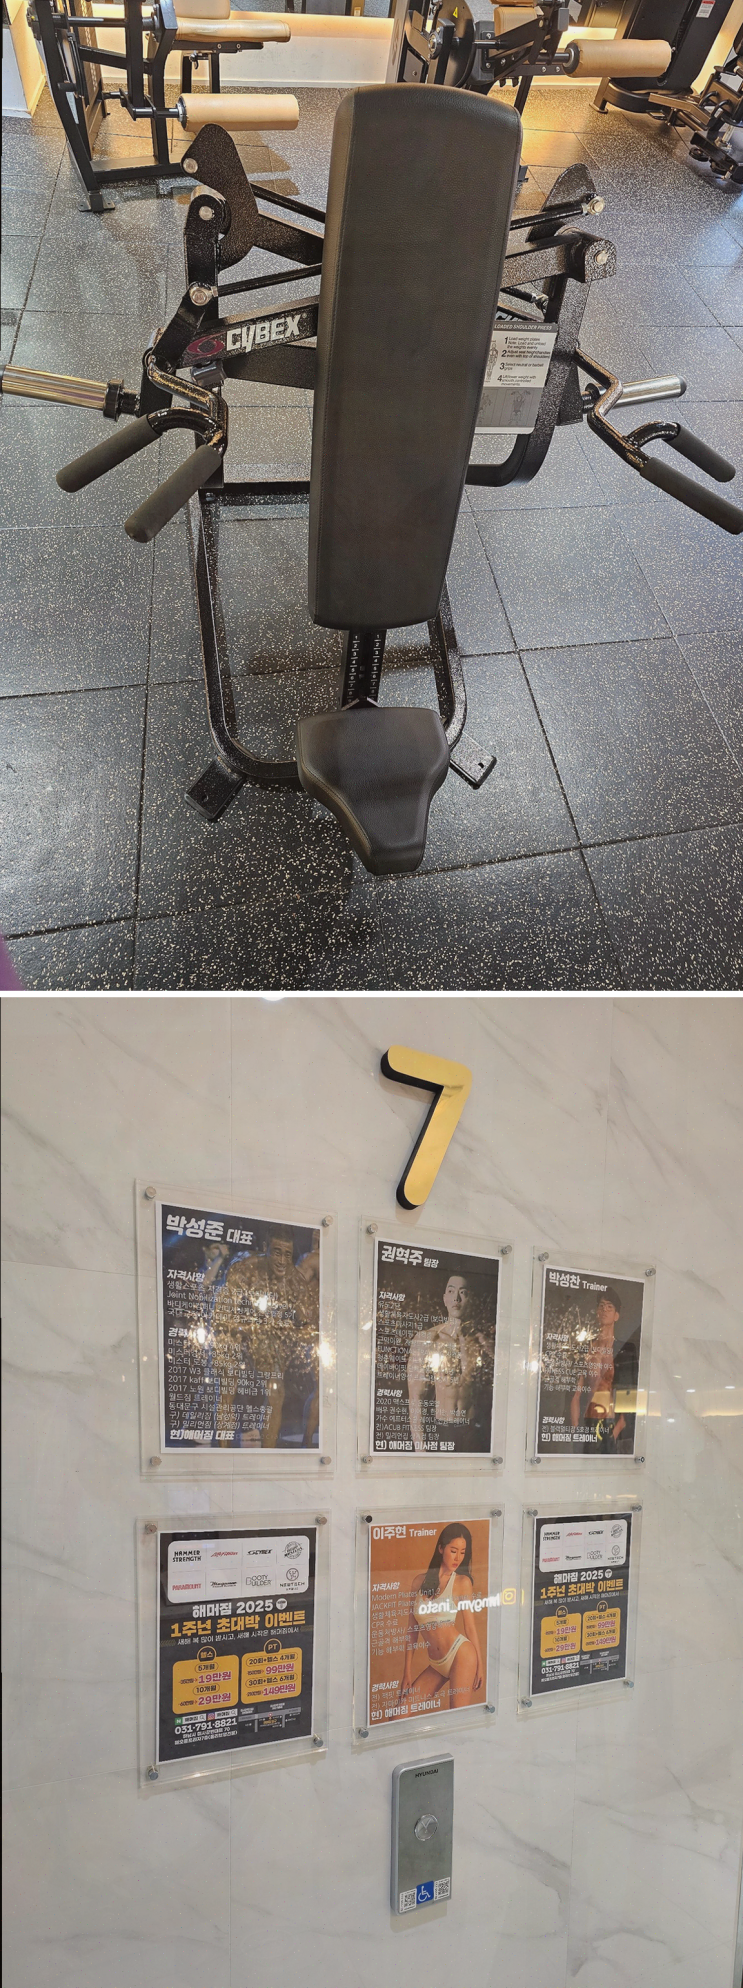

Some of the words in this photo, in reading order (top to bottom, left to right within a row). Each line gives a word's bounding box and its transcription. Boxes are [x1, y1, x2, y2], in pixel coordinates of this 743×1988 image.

[226, 313, 302, 352] CYBEX
[380, 1044, 472, 1210] 7
[166, 1214, 224, 1241] 박성준
[226, 1228, 254, 1244] 대표
[381, 1245, 424, 1266] 권혁주
[423, 1258, 439, 1268] 팀장
[167, 1269, 205, 1282] 자격사항
[549, 1272, 580, 1289] 박성찬
[582, 1281, 608, 1292] Trainer
[379, 1291, 406, 1301] 자격사항
[227, 1369, 254, 1378] 보디빌딩
[257, 1370, 284, 1379] 그랑프리
[237, 1379, 254, 1388] 90kg
[256, 1380, 267, 1388] 2위
[189, 1385, 204, 1393] 노원
[206, 1386, 235, 1395] 보디빌딩
[237, 1387, 258, 1396] 헤비급
[260, 1388, 271, 1396] 1위
[377, 1389, 402, 1397] 경력사항
[168, 1394, 191, 1402] 월드짐
[193, 1394, 223, 1402] 트레이너
[201, 1403, 244, 1412] 시설관리공단
[169, 1411, 180, 1419] 구)
[182, 1411, 212, 1420] 데일리짐
[214, 1413, 240, 1421] (남성역)
[242, 1414, 270, 1422] 트레이너
[169, 1420, 180, 1428] 구)
[182, 1420, 212, 1429] 밀리언짐
[242, 1422, 270, 1430] 트레이너
[170, 1429, 213, 1440] 현)해머짐
[215, 1430, 235, 1440] 대표
[573, 1434, 598, 1443] 트레이너
[376, 1441, 387, 1450] 현)
[389, 1441, 412, 1450] 해머짐
[415, 1441, 437, 1450] 미사점
[440, 1441, 455, 1450] 팀장
[373, 1526, 406, 1540] 이주현
[409, 1528, 437, 1537] Trainer
[554, 1572, 578, 1584] 해머짐
[580, 1570, 604, 1580] 2025
[372, 1582, 400, 1592] 자격사항
[540, 1584, 565, 1599] 1주년
[568, 1582, 595, 1596] 초대박
[598, 1579, 624, 1592] 이벤트
[372, 1592, 396, 1601] Modern
[192, 1602, 232, 1618] 해머짐
[236, 1600, 273, 1614] 2025
[170, 1619, 212, 1638] 1주년
[216, 1615, 260, 1632] 초대박
[265, 1610, 306, 1628] 이벤트
[386, 1619, 398, 1627] 수료
[597, 1620, 615, 1629] 99만원
[556, 1626, 576, 1635] 19만원
[595, 1636, 616, 1645] 149만원
[372, 1647, 383, 1656] 기능
[556, 1642, 576, 1652] 29만원
[200, 1651, 212, 1659] 헬스
[249, 1656, 278, 1665] 20회+헬스
[265, 1663, 294, 1674] 99만원
[198, 1671, 232, 1684] 19만원
[248, 1677, 277, 1686] 30회+헬스
[263, 1683, 296, 1696] 149만원
[372, 1680, 399, 1692] 경력사항
[198, 1693, 231, 1706] 29만원
[371, 1710, 382, 1720] 현)
[385, 1706, 408, 1717] 해머짐
[410, 1699, 441, 1712] 트레이너
[415, 1769, 439, 1778] HYUNDAI
